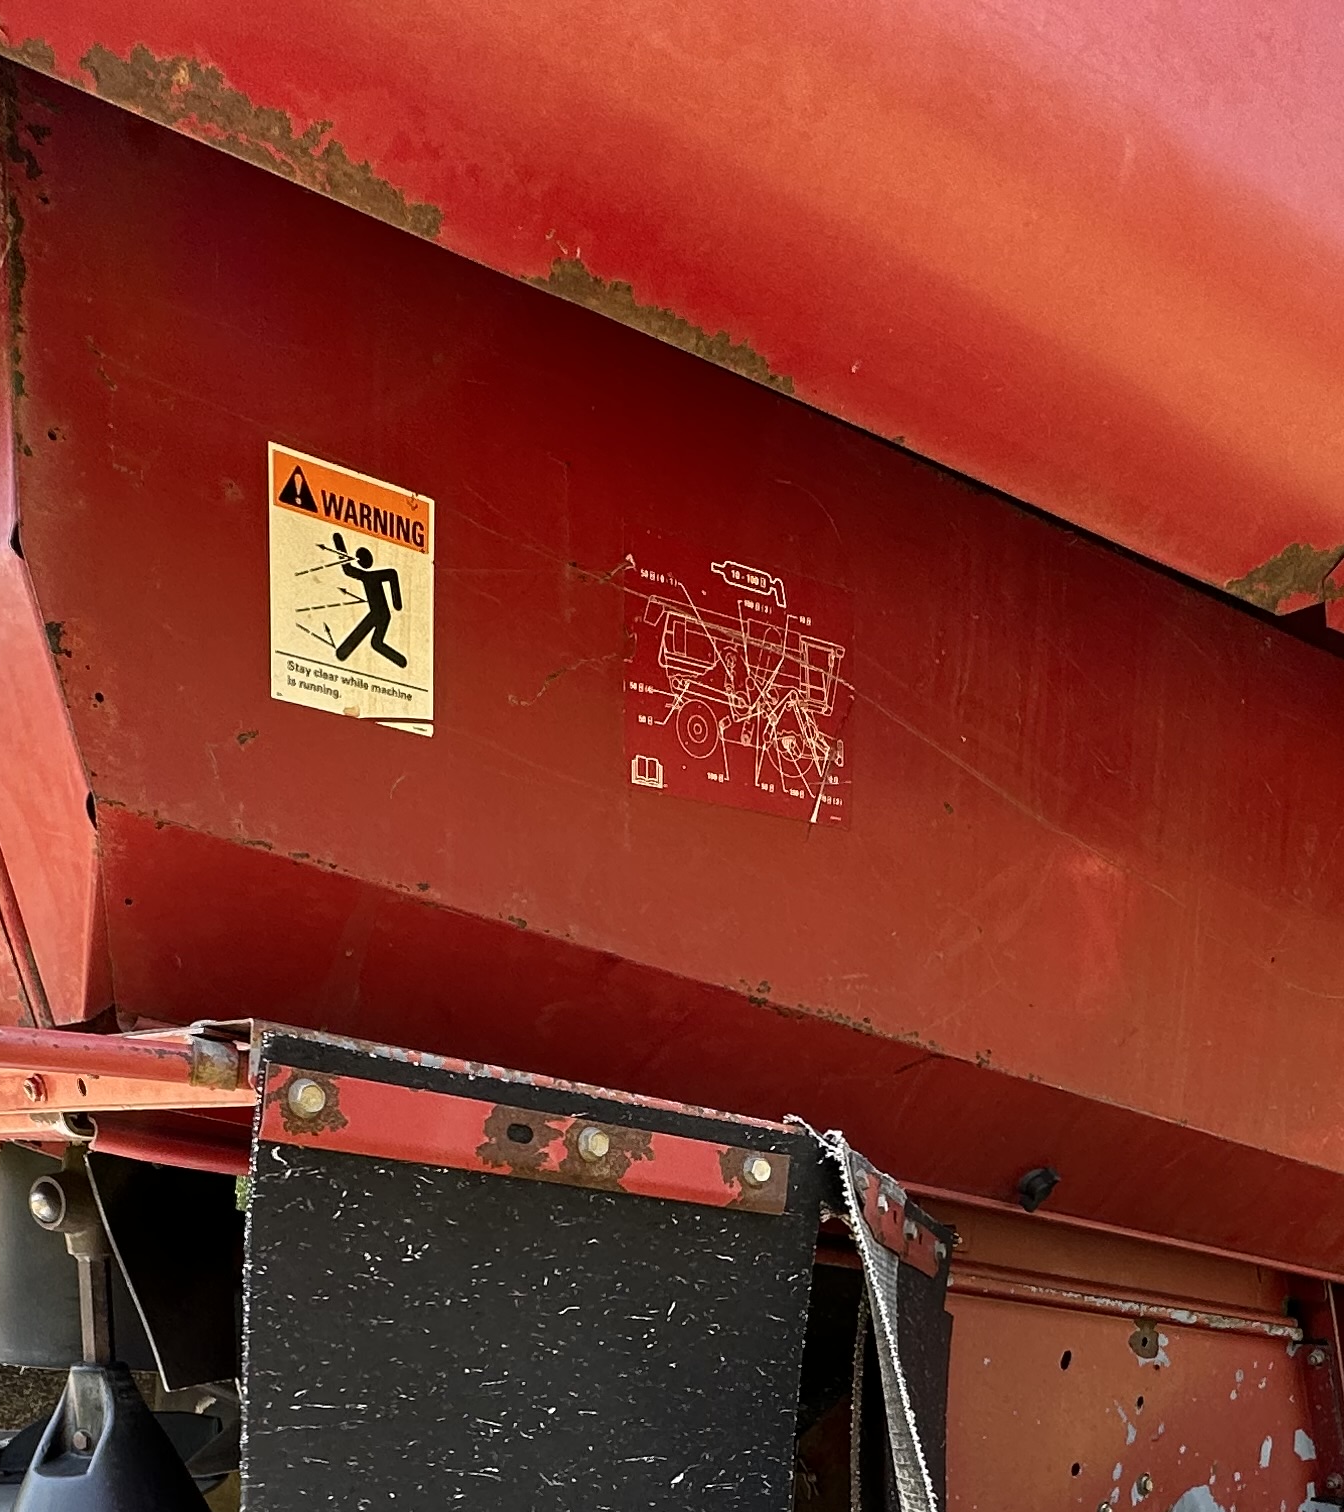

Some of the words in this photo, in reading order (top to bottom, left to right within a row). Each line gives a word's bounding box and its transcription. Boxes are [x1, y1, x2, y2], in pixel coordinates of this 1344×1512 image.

[321, 489, 426, 548] WARNING
[286, 660, 312, 677] Stay
[313, 668, 339, 682] clear
[340, 675, 369, 690] while
[371, 683, 413, 702] machine
[286, 675, 297, 686] is
[298, 680, 342, 699] running.
